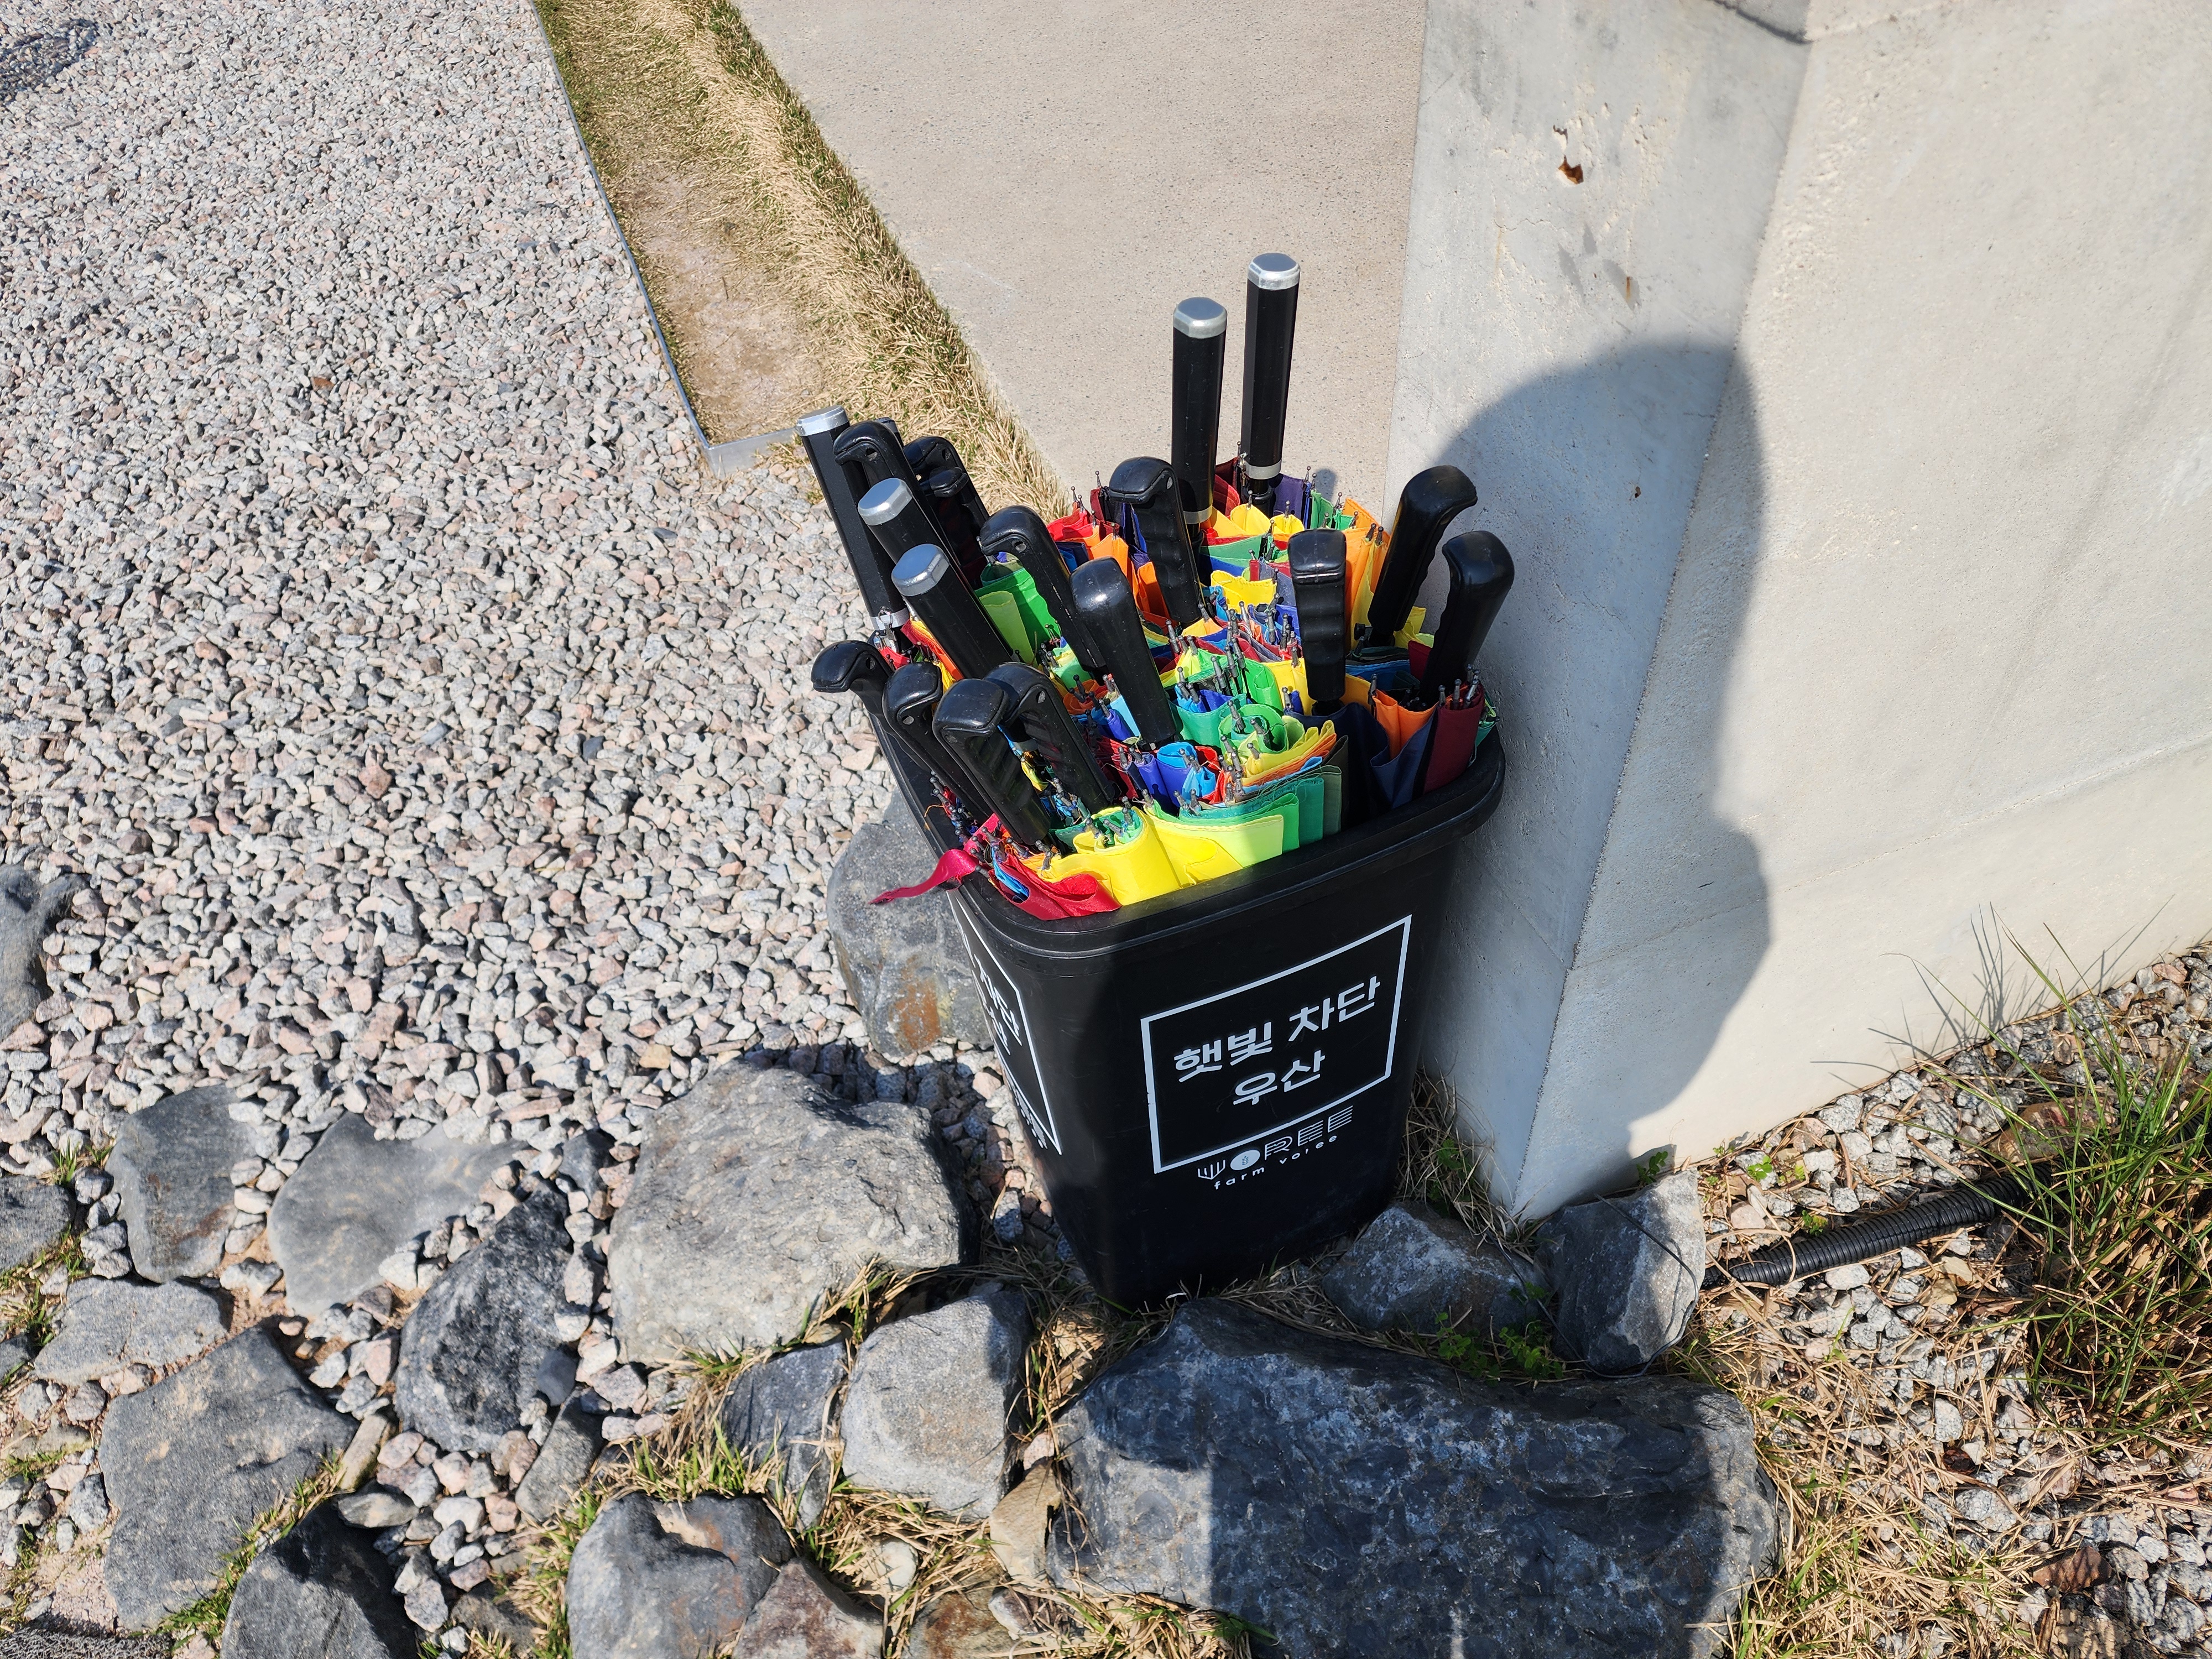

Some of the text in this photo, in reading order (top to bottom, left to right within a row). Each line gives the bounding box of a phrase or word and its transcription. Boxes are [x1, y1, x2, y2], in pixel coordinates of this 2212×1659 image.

[1175, 976, 1381, 1082] 햇빛 차단
[1233, 1050, 1326, 1105] 우산
[1214, 1166, 1265, 1190] farm
